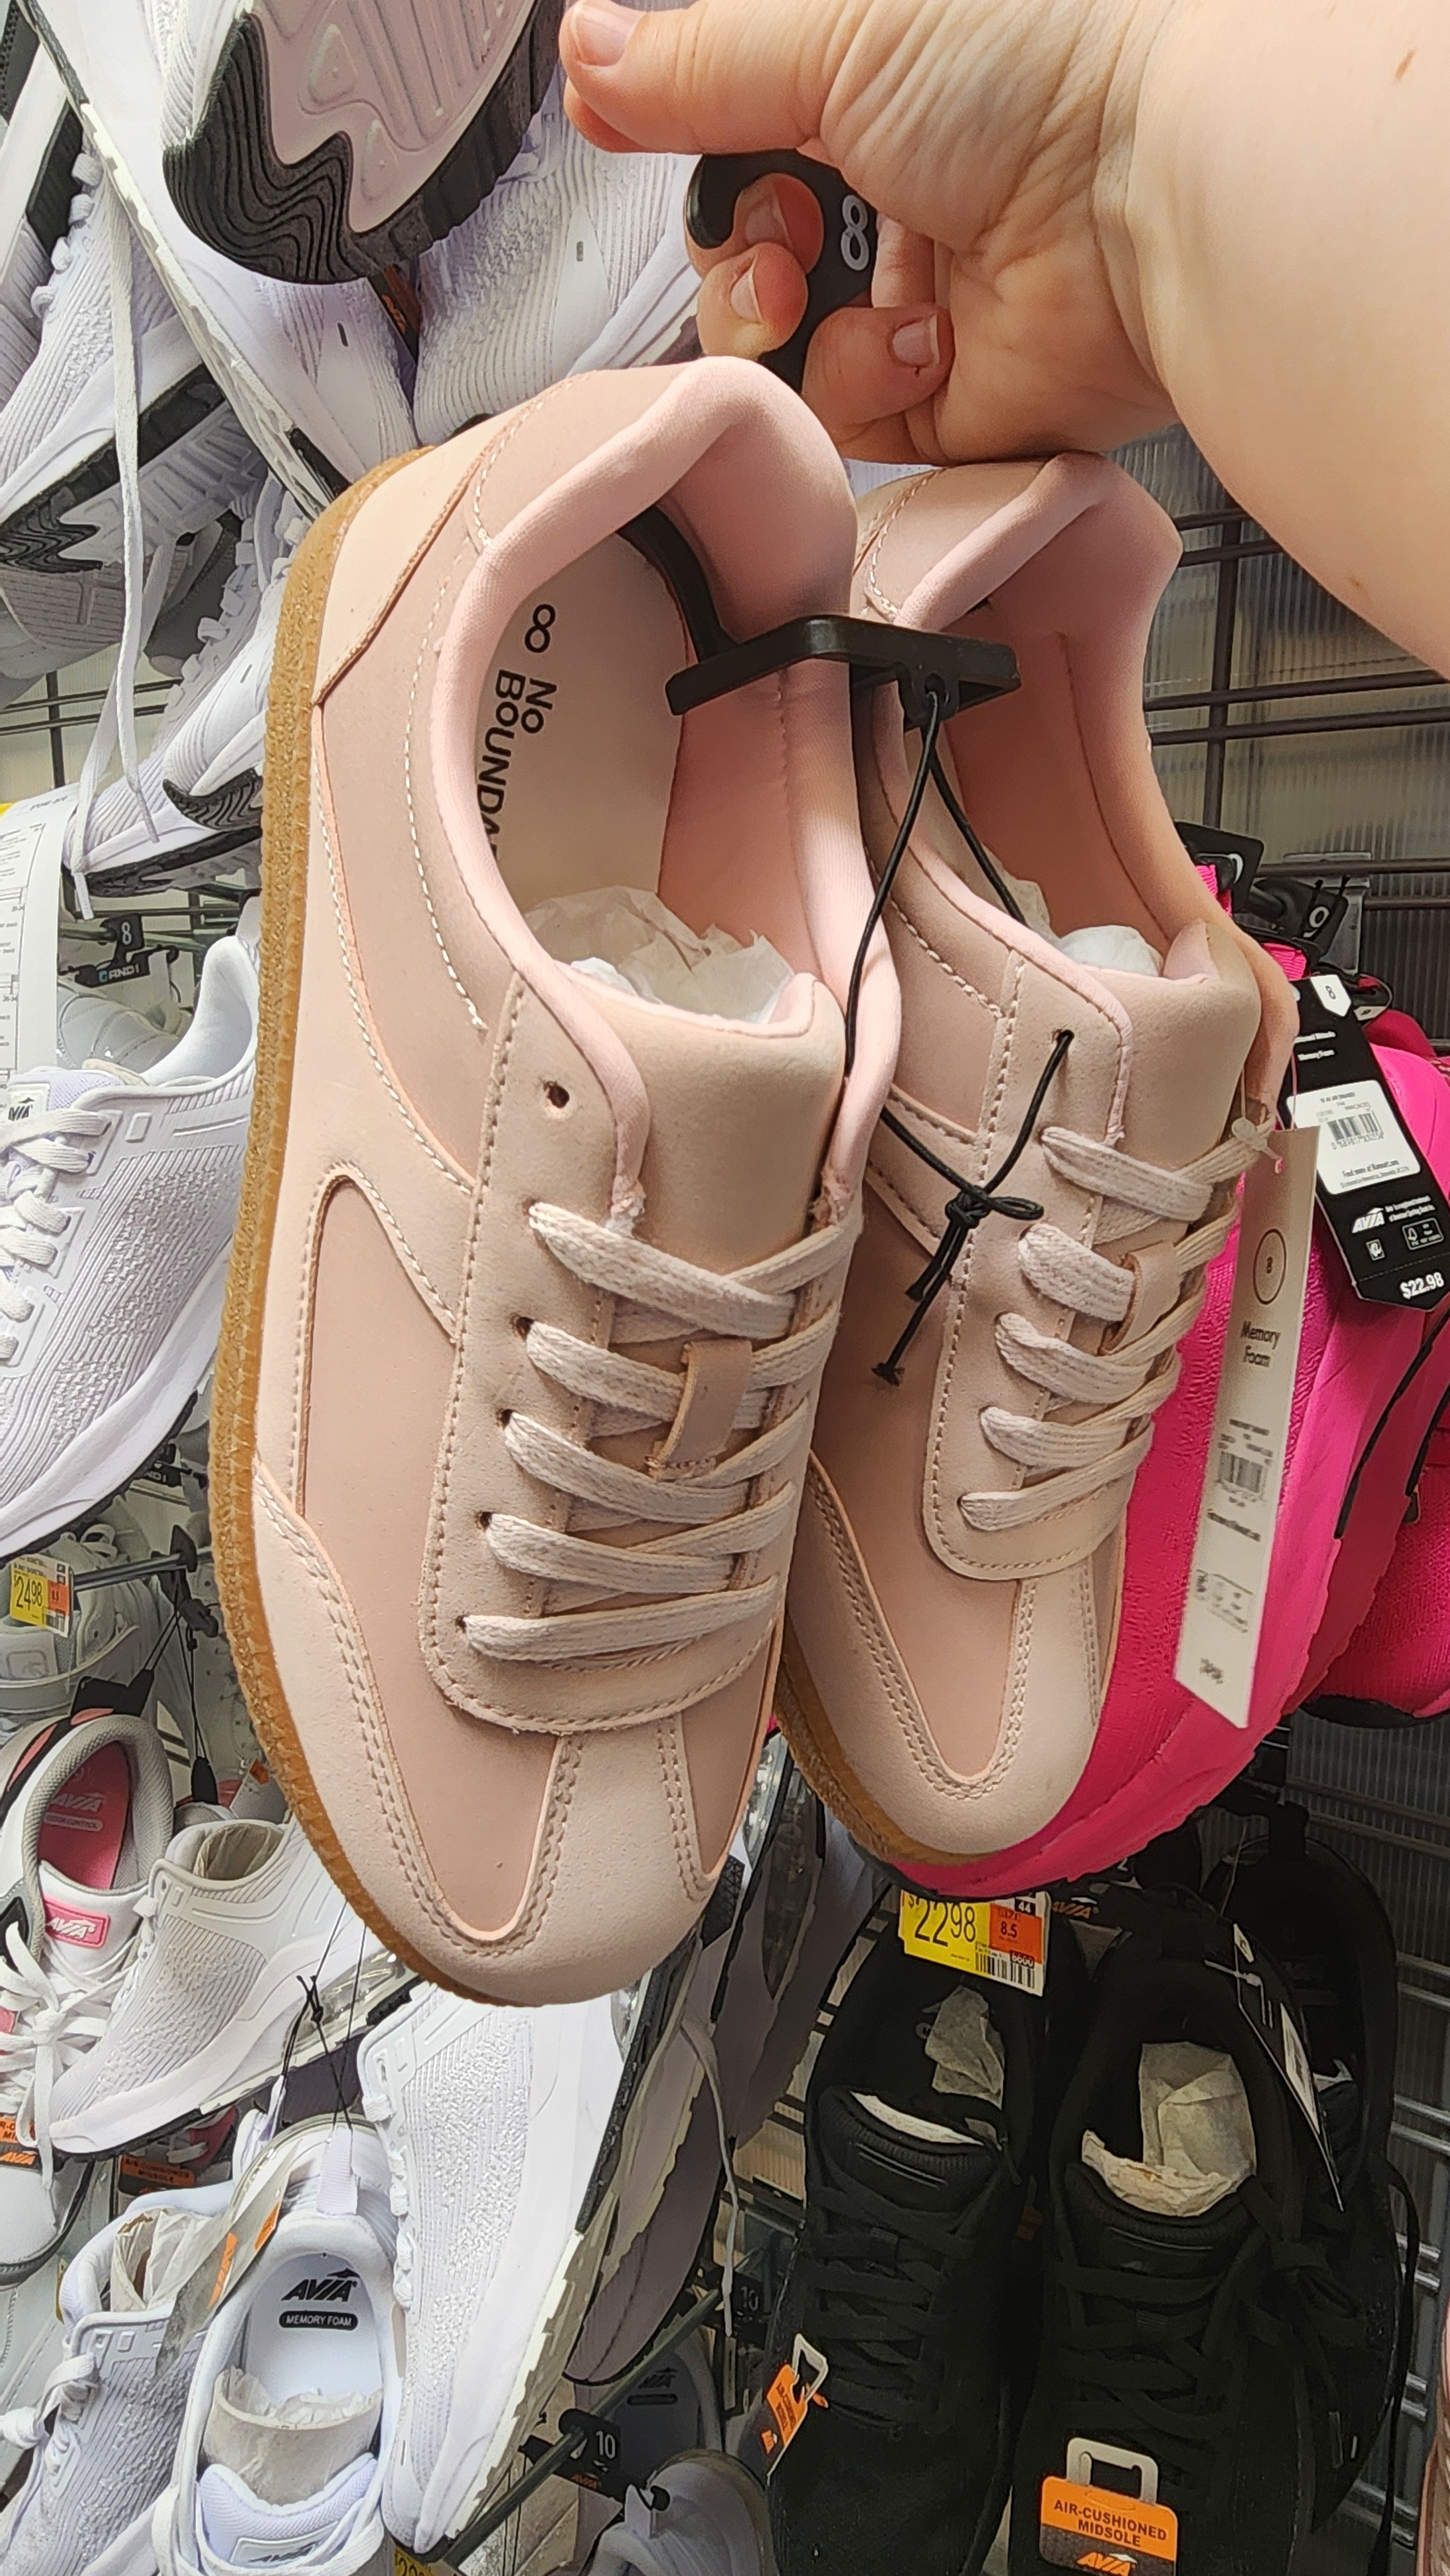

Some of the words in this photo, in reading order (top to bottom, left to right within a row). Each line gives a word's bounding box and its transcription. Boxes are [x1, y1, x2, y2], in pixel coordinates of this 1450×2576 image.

[840, 194, 870, 271] 8
[122, 922, 132, 945] 8
[1325, 985, 1337, 1000] 8
[1352, 1211, 1385, 1233] AVIA
[1400, 1271, 1444, 1300] $22.98
[1240, 1320, 1281, 1350] Memory
[1242, 1345, 1270, 1368] Foam
[46, 1917, 88, 1939] AVIA
[1000, 1921, 1018, 1939] 8.5
[281, 2278, 352, 2302] AVIA
[742, 2287, 759, 2312] 10
[285, 2315, 326, 2325] MEMORY
[327, 2315, 352, 2327] FOAM
[596, 2430, 616, 2459] 10
[1053, 2499, 1167, 2541] AIR-CUSHIONED
[1077, 2519, 1142, 2547] MIDSOLE
[1075, 2551, 1131, 2576] AVIA
